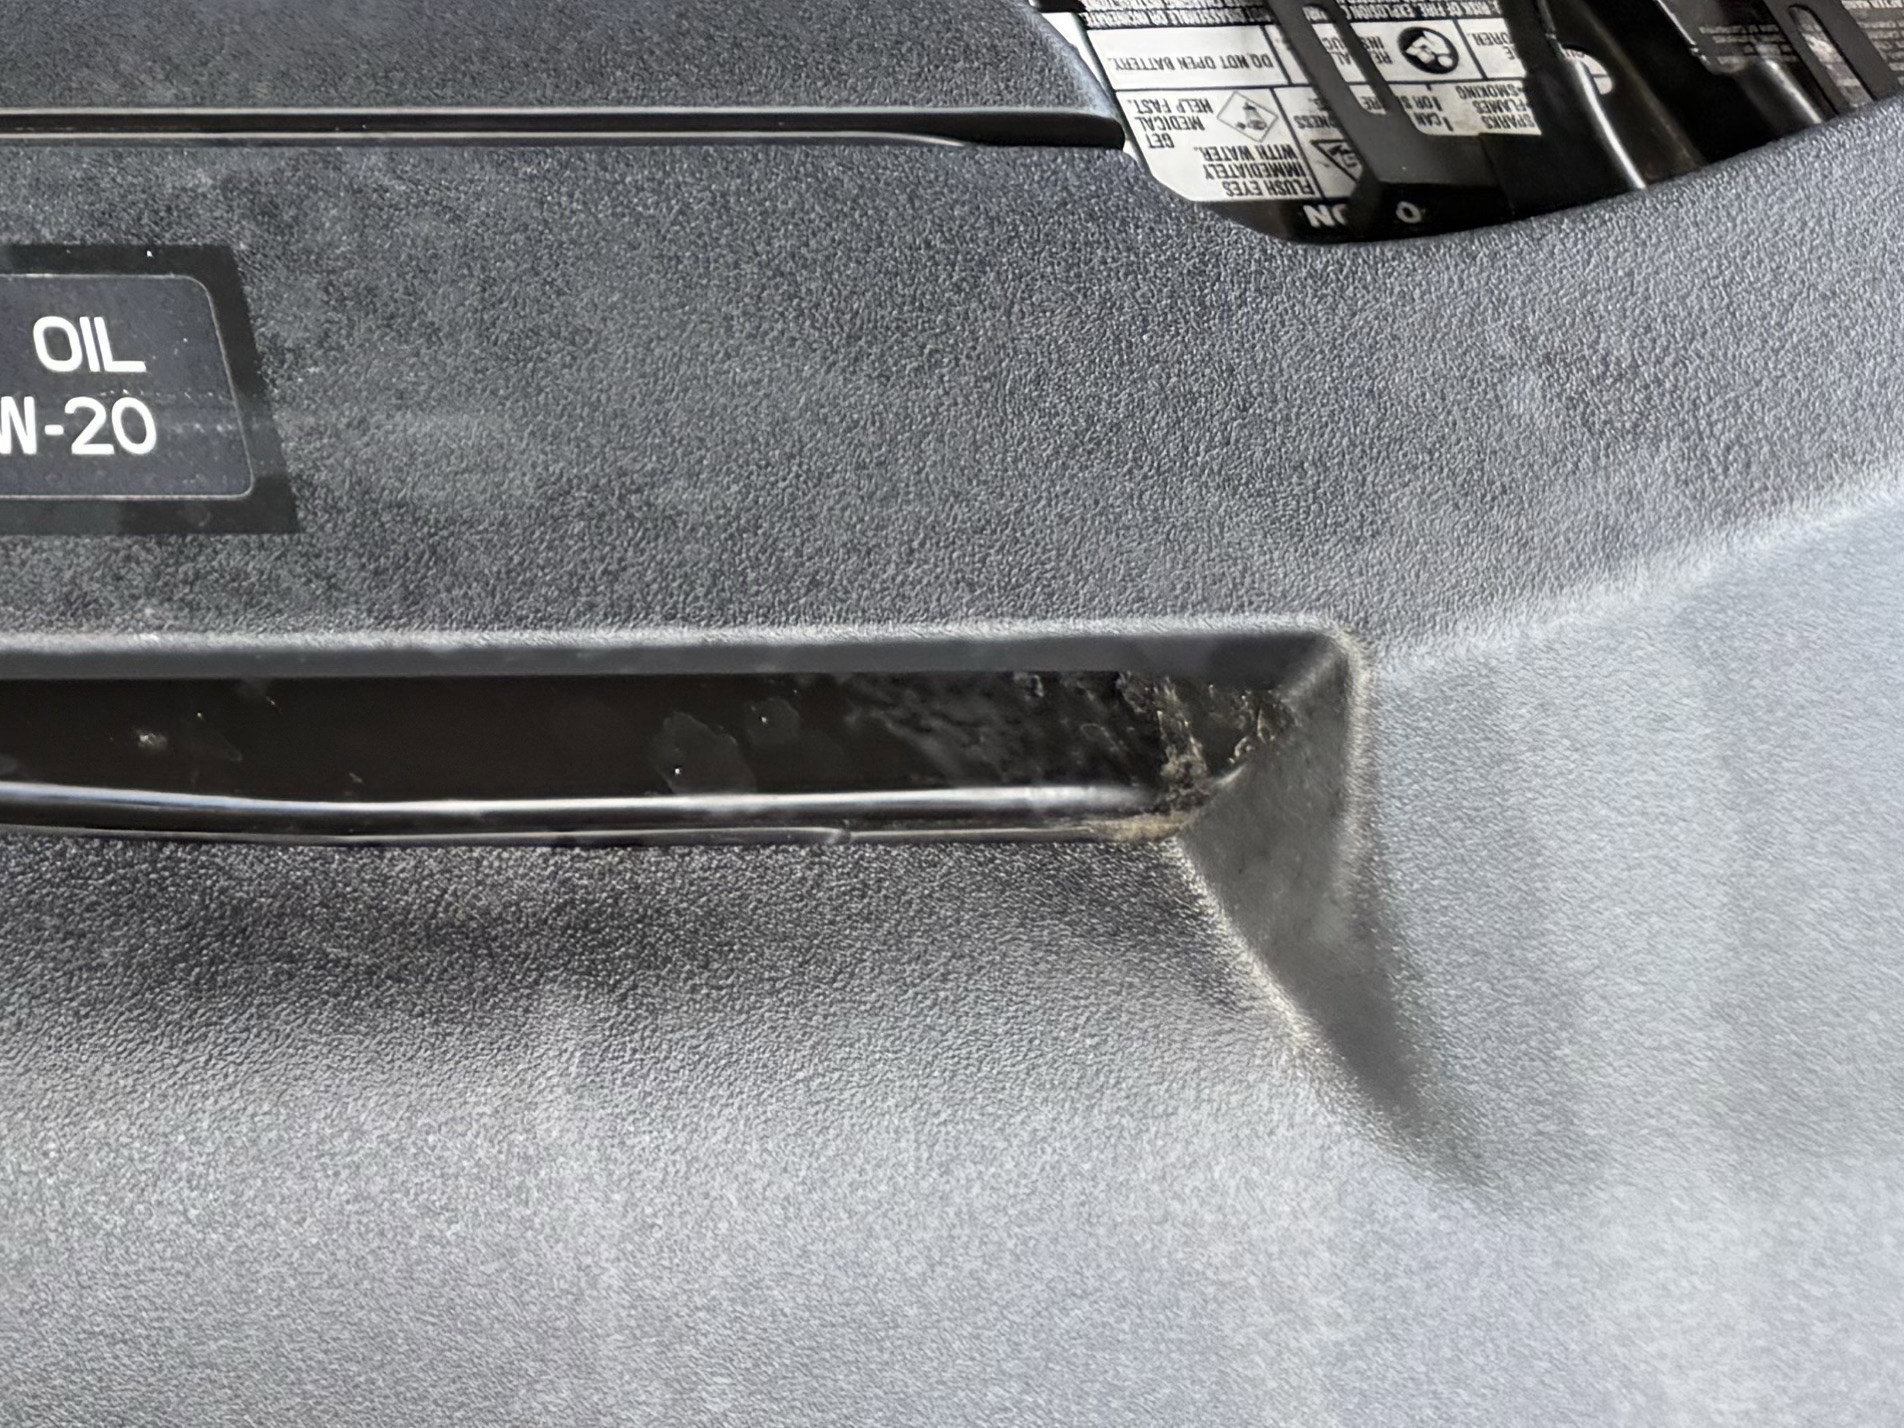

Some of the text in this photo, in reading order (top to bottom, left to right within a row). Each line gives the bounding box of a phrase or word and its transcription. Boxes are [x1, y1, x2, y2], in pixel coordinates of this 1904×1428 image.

[1458, 1, 1492, 17] RISK
[1108, 56, 1176, 71] BATTERY.
[1176, 55, 1217, 71] OPEN
[1218, 54, 1251, 70] NOT
[1127, 99, 1214, 114] HELP FAST.
[1134, 115, 1206, 131] MEDICAL
[1481, 114, 1536, 130] SPARKS
[1143, 132, 1175, 149] GET
[1193, 143, 1299, 163] WITH WATER.
[1202, 161, 1307, 180] IMMEDIATELY
[1221, 178, 1316, 197] FLUSH EYES
[32, 315, 147, 373] OIL
